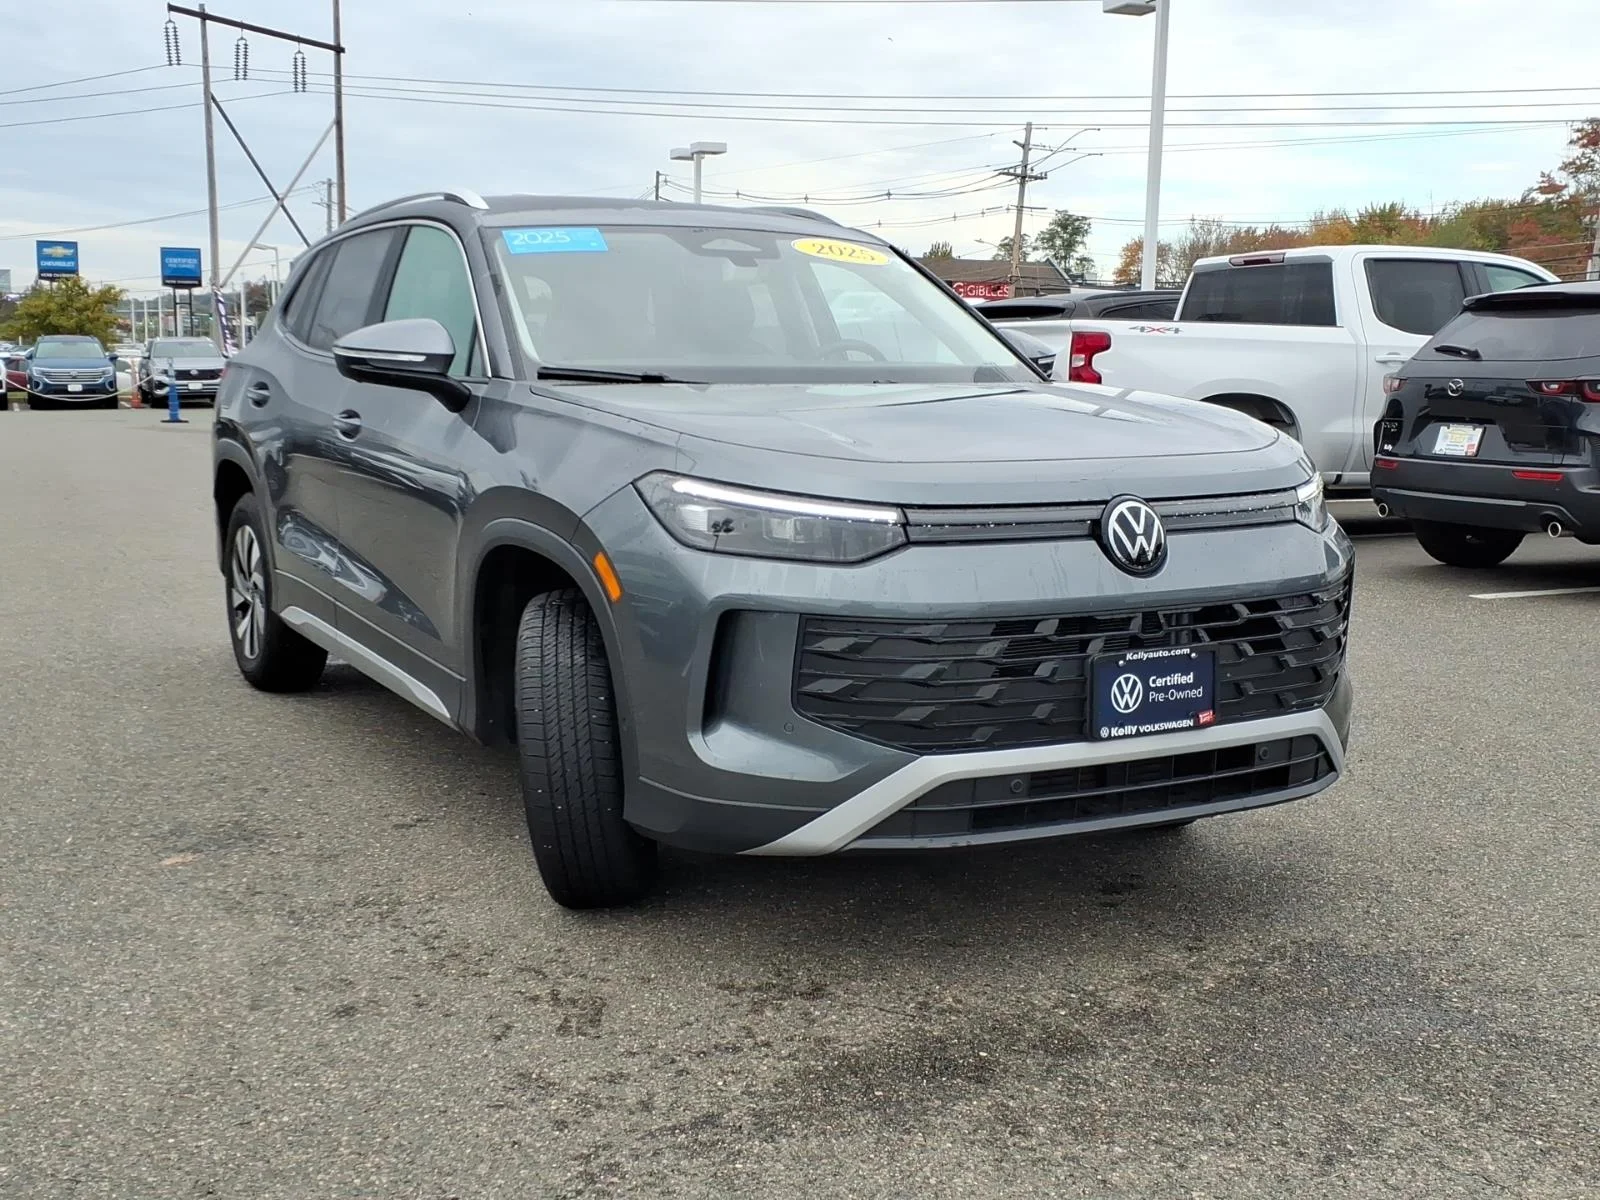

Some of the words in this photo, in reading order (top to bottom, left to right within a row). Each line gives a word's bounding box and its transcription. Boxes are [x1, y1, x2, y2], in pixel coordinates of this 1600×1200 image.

[511, 231, 572, 245] 2025
[811, 243, 875, 261] 2025
[1126, 648, 1190, 661] Kellyauto.com
[1149, 672, 1194, 688] Certified
[1149, 686, 1203, 702] Pre-Owned
[1111, 725, 1138, 737] Kelly
[1139, 719, 1194, 733] VOLKSWAGEN
